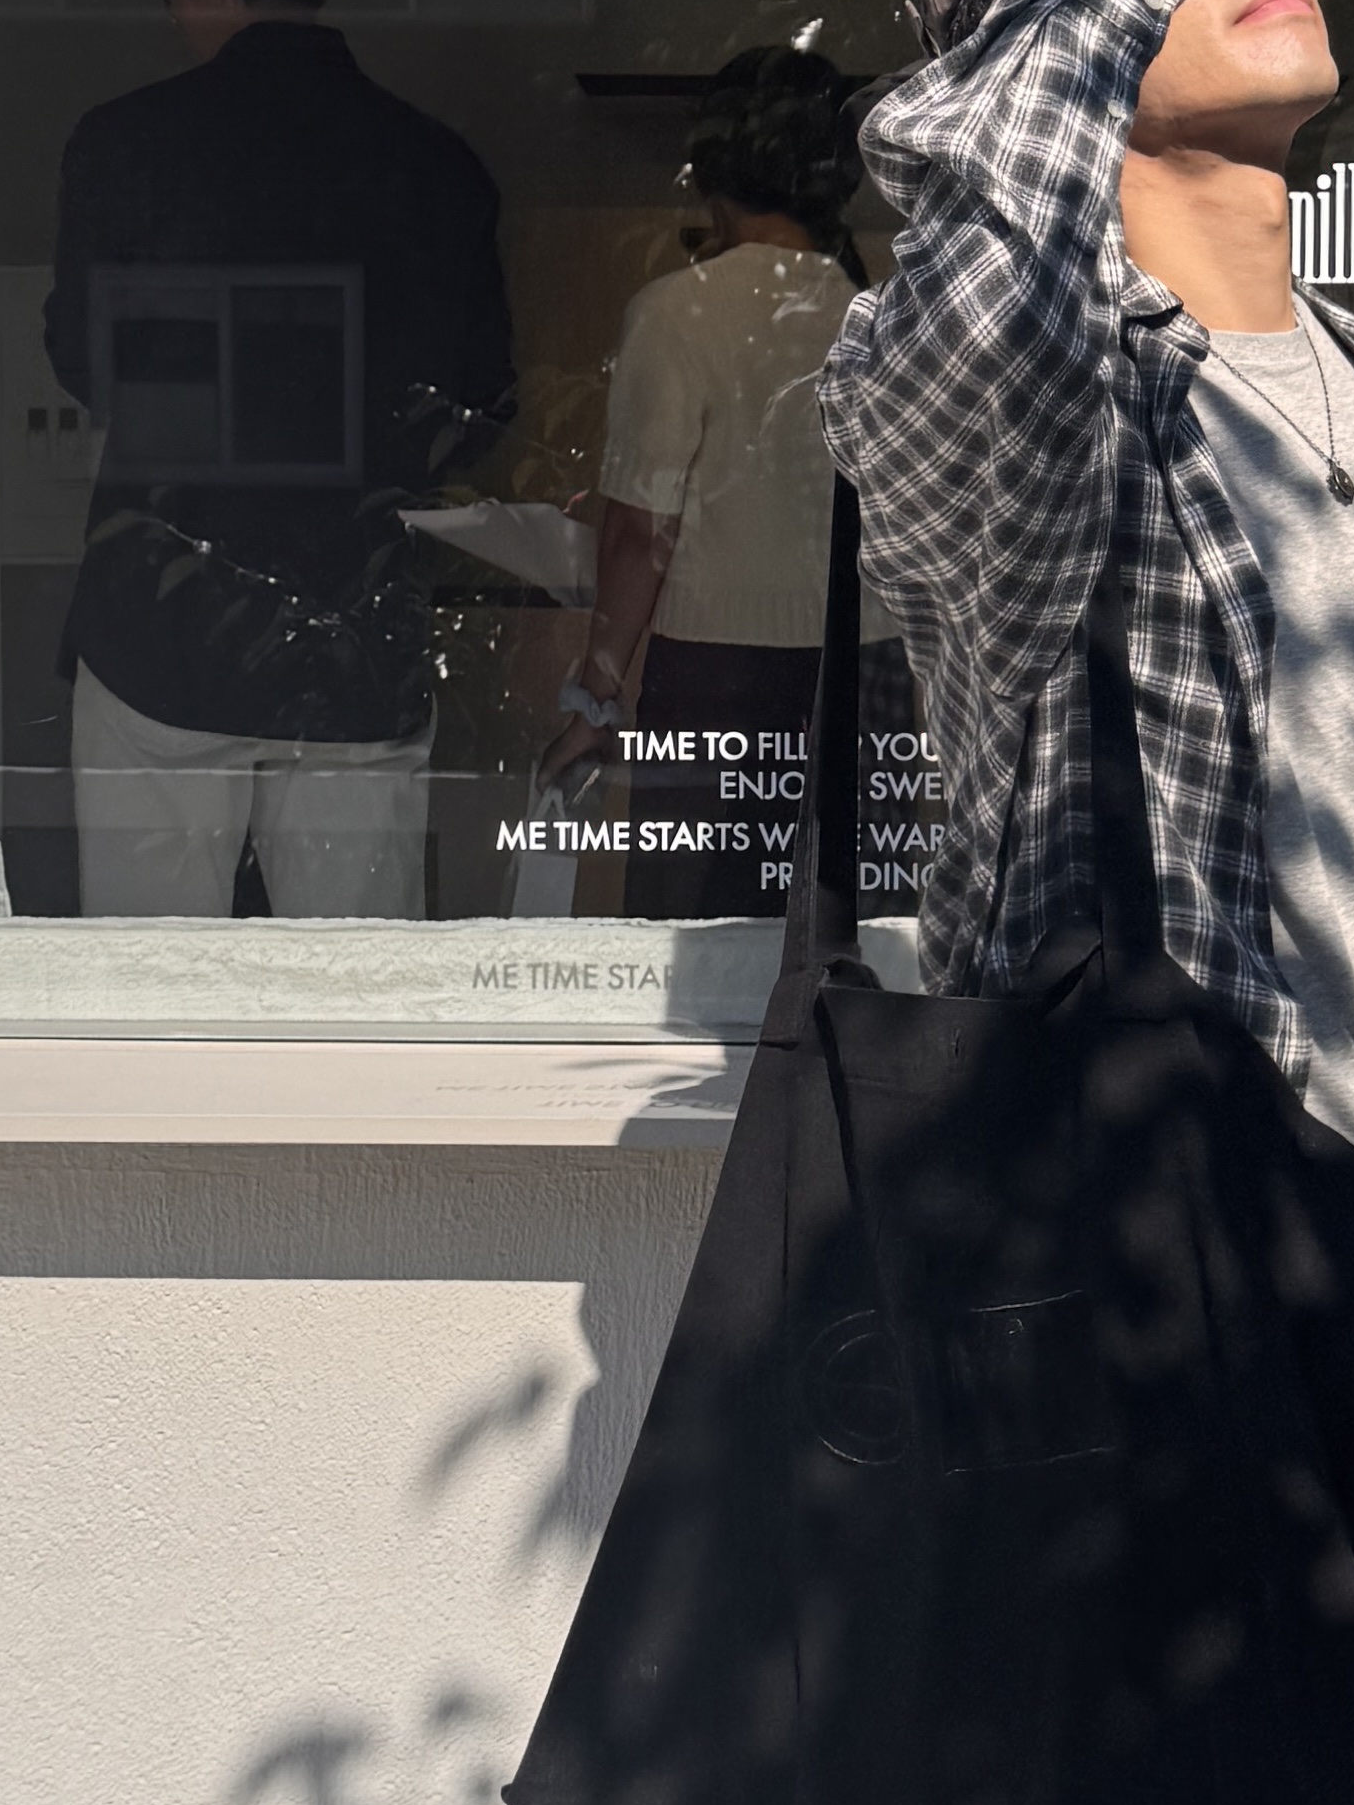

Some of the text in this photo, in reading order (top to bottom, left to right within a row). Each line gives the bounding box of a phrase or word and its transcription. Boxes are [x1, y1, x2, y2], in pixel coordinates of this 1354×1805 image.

[618, 730, 696, 761] TIME
[702, 731, 749, 761] TO
[758, 732, 808, 761] FILL
[496, 820, 547, 851] ME
[553, 820, 631, 851] TIME
[638, 821, 751, 851] STARTS
[472, 962, 518, 990] ME
[526, 962, 599, 991] TIME
